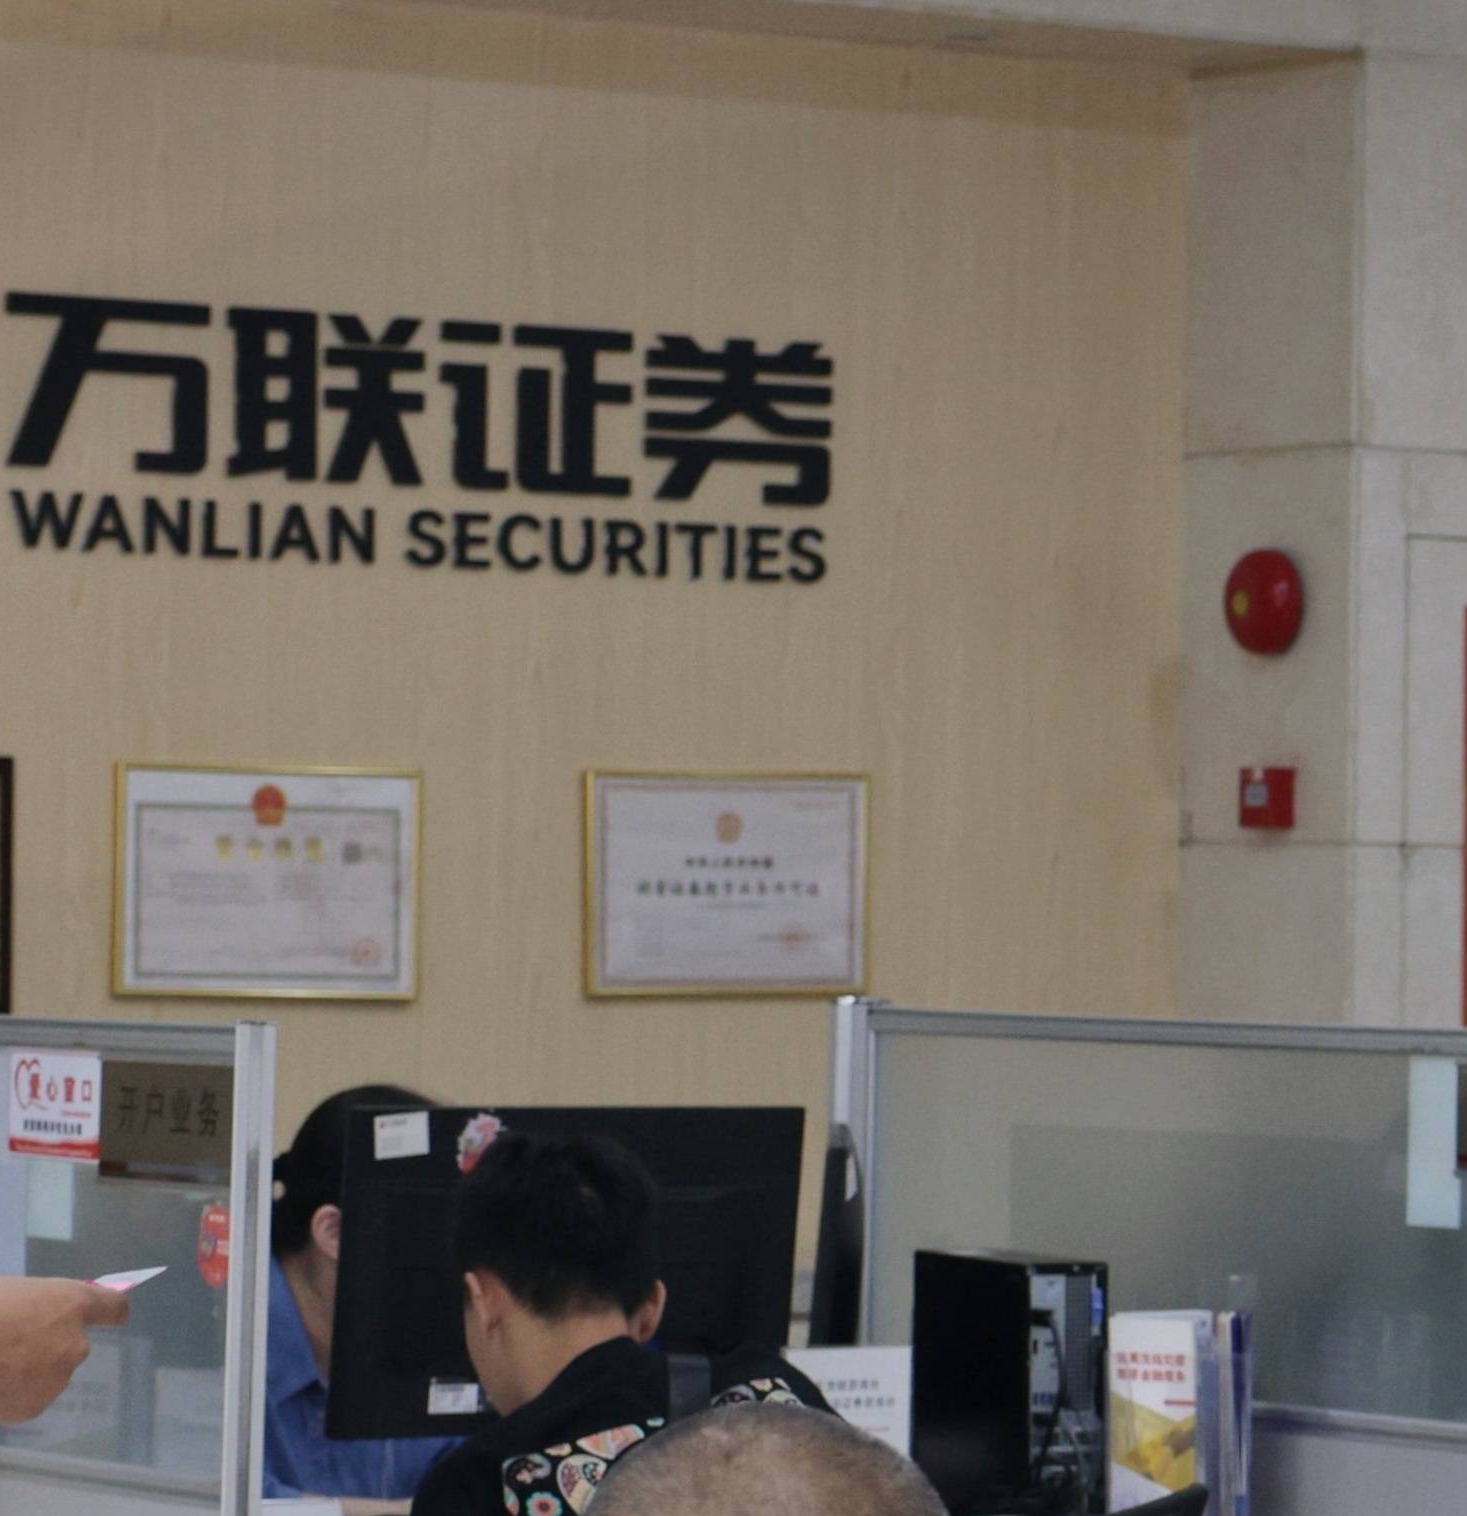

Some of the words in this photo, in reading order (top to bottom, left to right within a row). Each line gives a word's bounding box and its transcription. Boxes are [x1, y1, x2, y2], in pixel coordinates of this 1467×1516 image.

[5, 290, 834, 506] 万联证券
[10, 487, 375, 566] WANLIAN
[405, 508, 828, 584] SECURITIES
[115, 1082, 221, 1138] 开户业务
